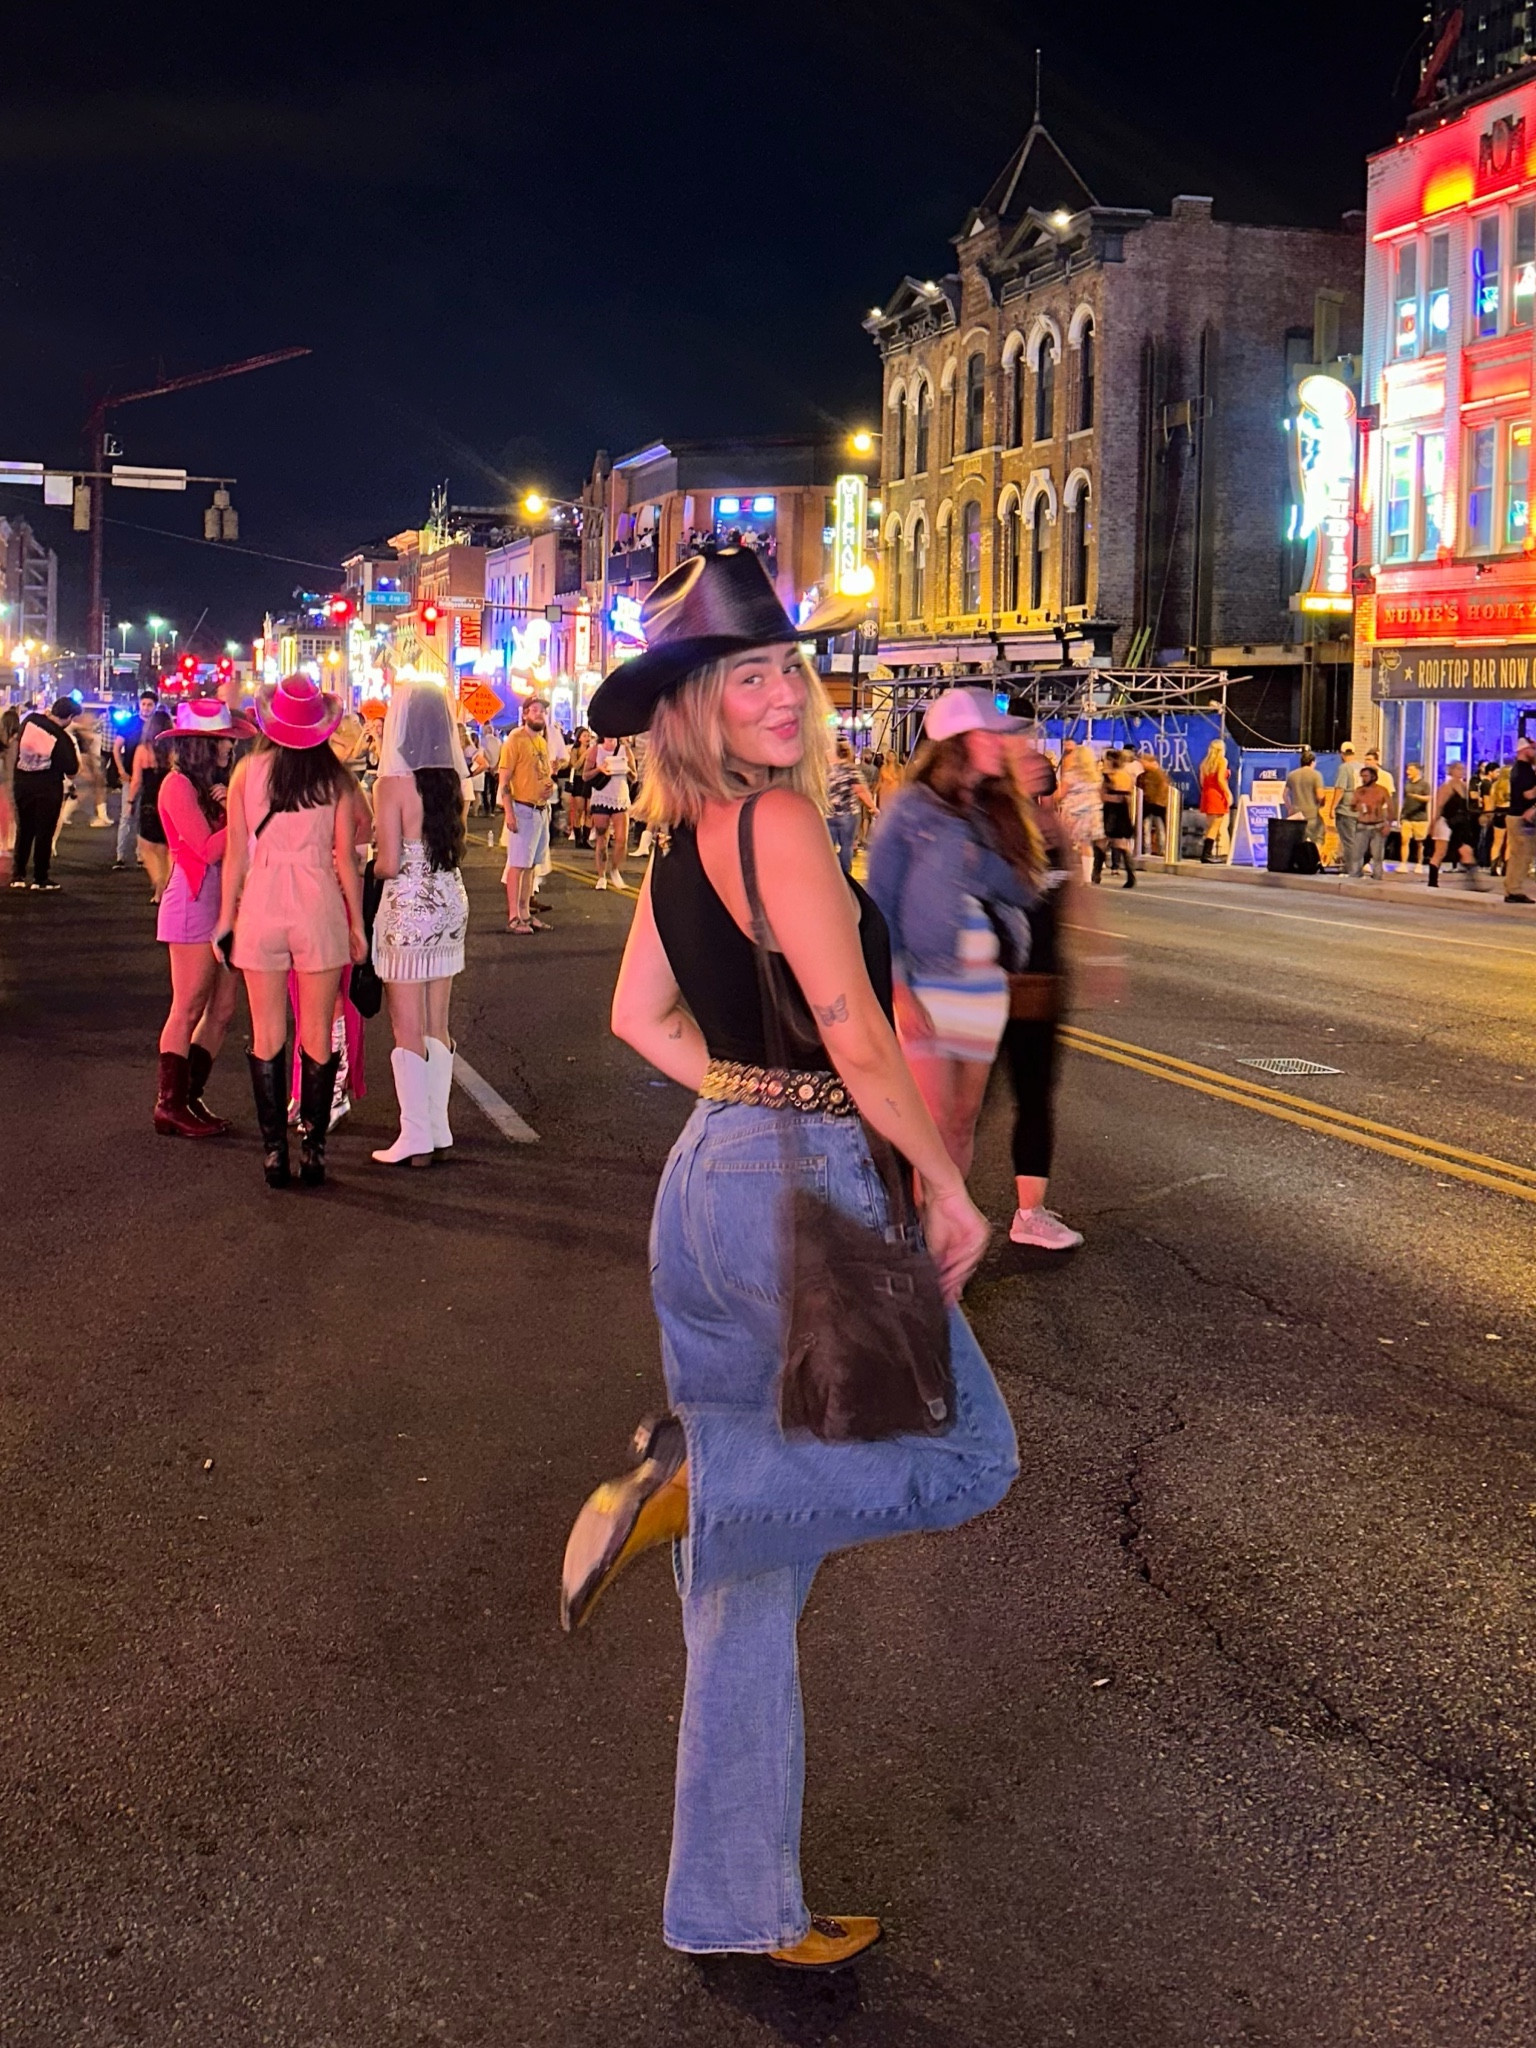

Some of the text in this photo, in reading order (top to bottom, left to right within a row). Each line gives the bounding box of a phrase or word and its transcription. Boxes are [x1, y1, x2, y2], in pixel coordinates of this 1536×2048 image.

[1384, 602, 1459, 623] NUDIE'S
[461, 616, 481, 647] JASO
[1418, 658, 1469, 688] ROOFTOP
[1473, 658, 1496, 688] BAR
[1500, 657, 1528, 689] NOW
